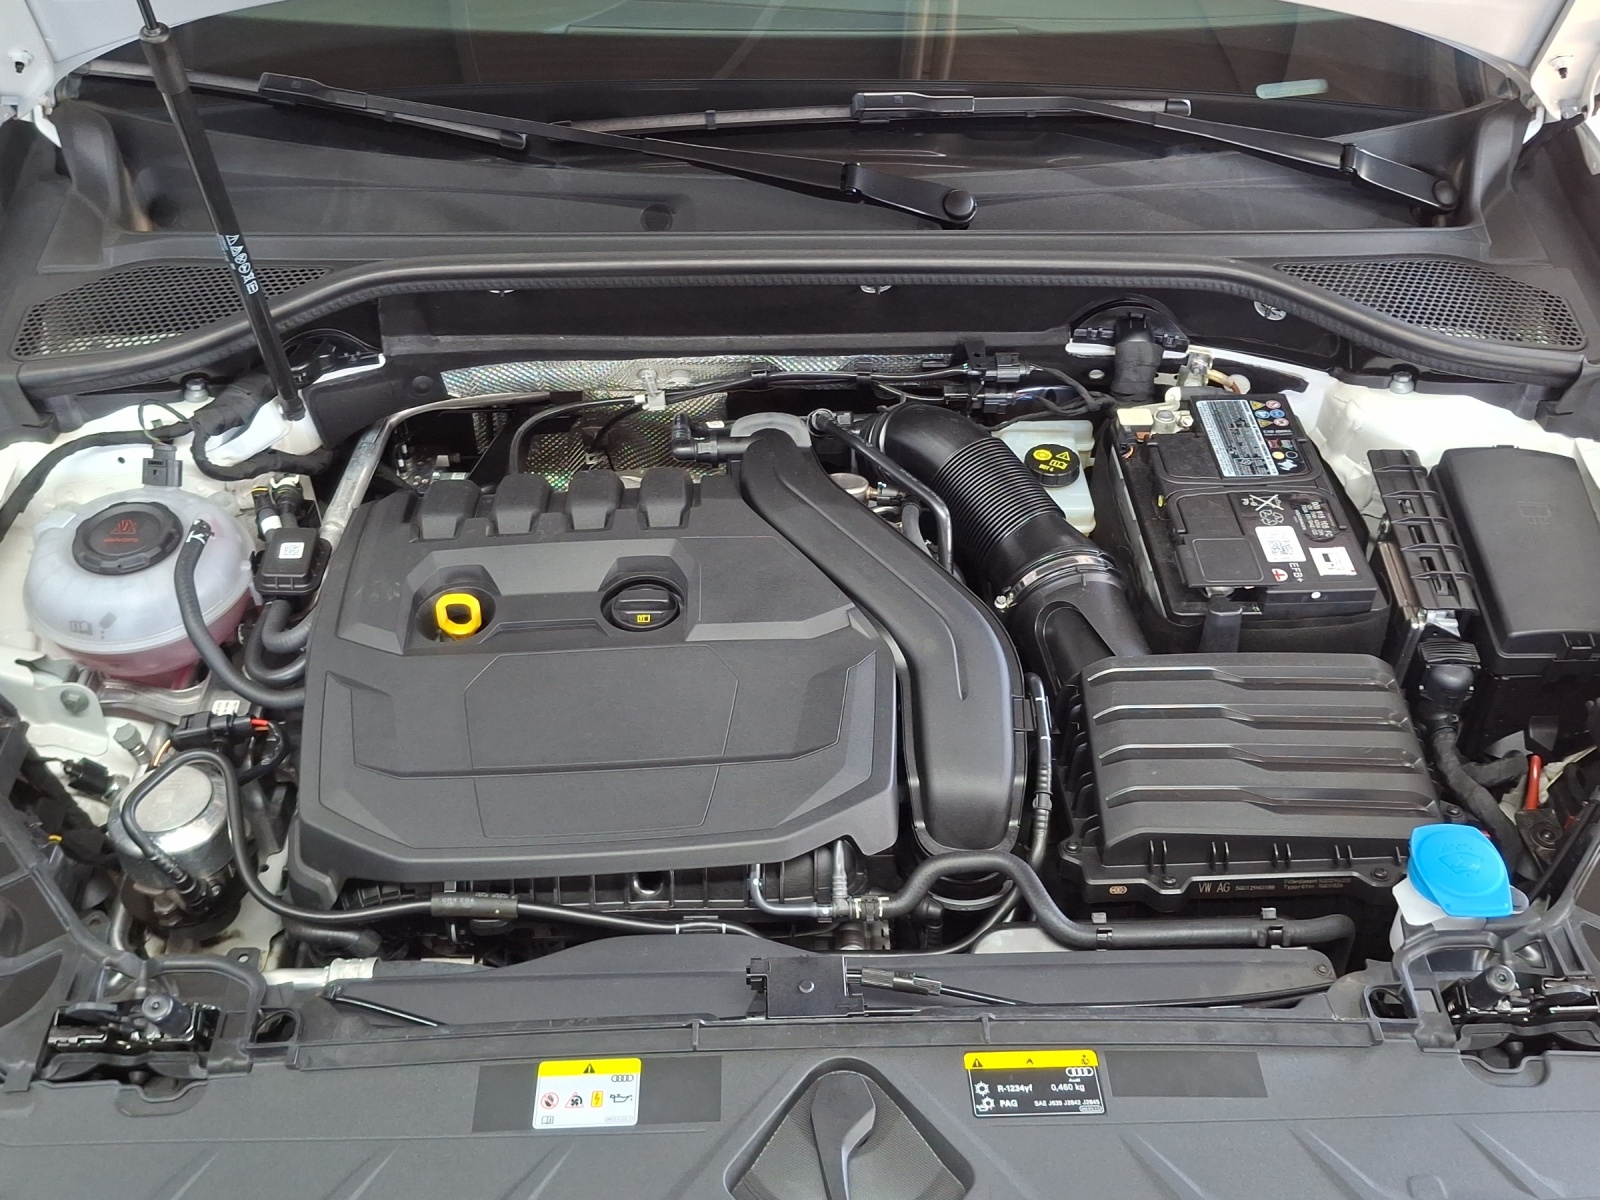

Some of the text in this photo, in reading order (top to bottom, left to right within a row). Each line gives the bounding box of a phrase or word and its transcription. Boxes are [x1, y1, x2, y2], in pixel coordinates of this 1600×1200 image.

[1289, 562, 1304, 582] EFB+
[1198, 882, 1212, 893] VW
[1216, 882, 1231, 893] AG
[997, 1083, 1033, 1093] R-1234yf
[1075, 1082, 1086, 1093] kg
[999, 1099, 1019, 1108] PAG
